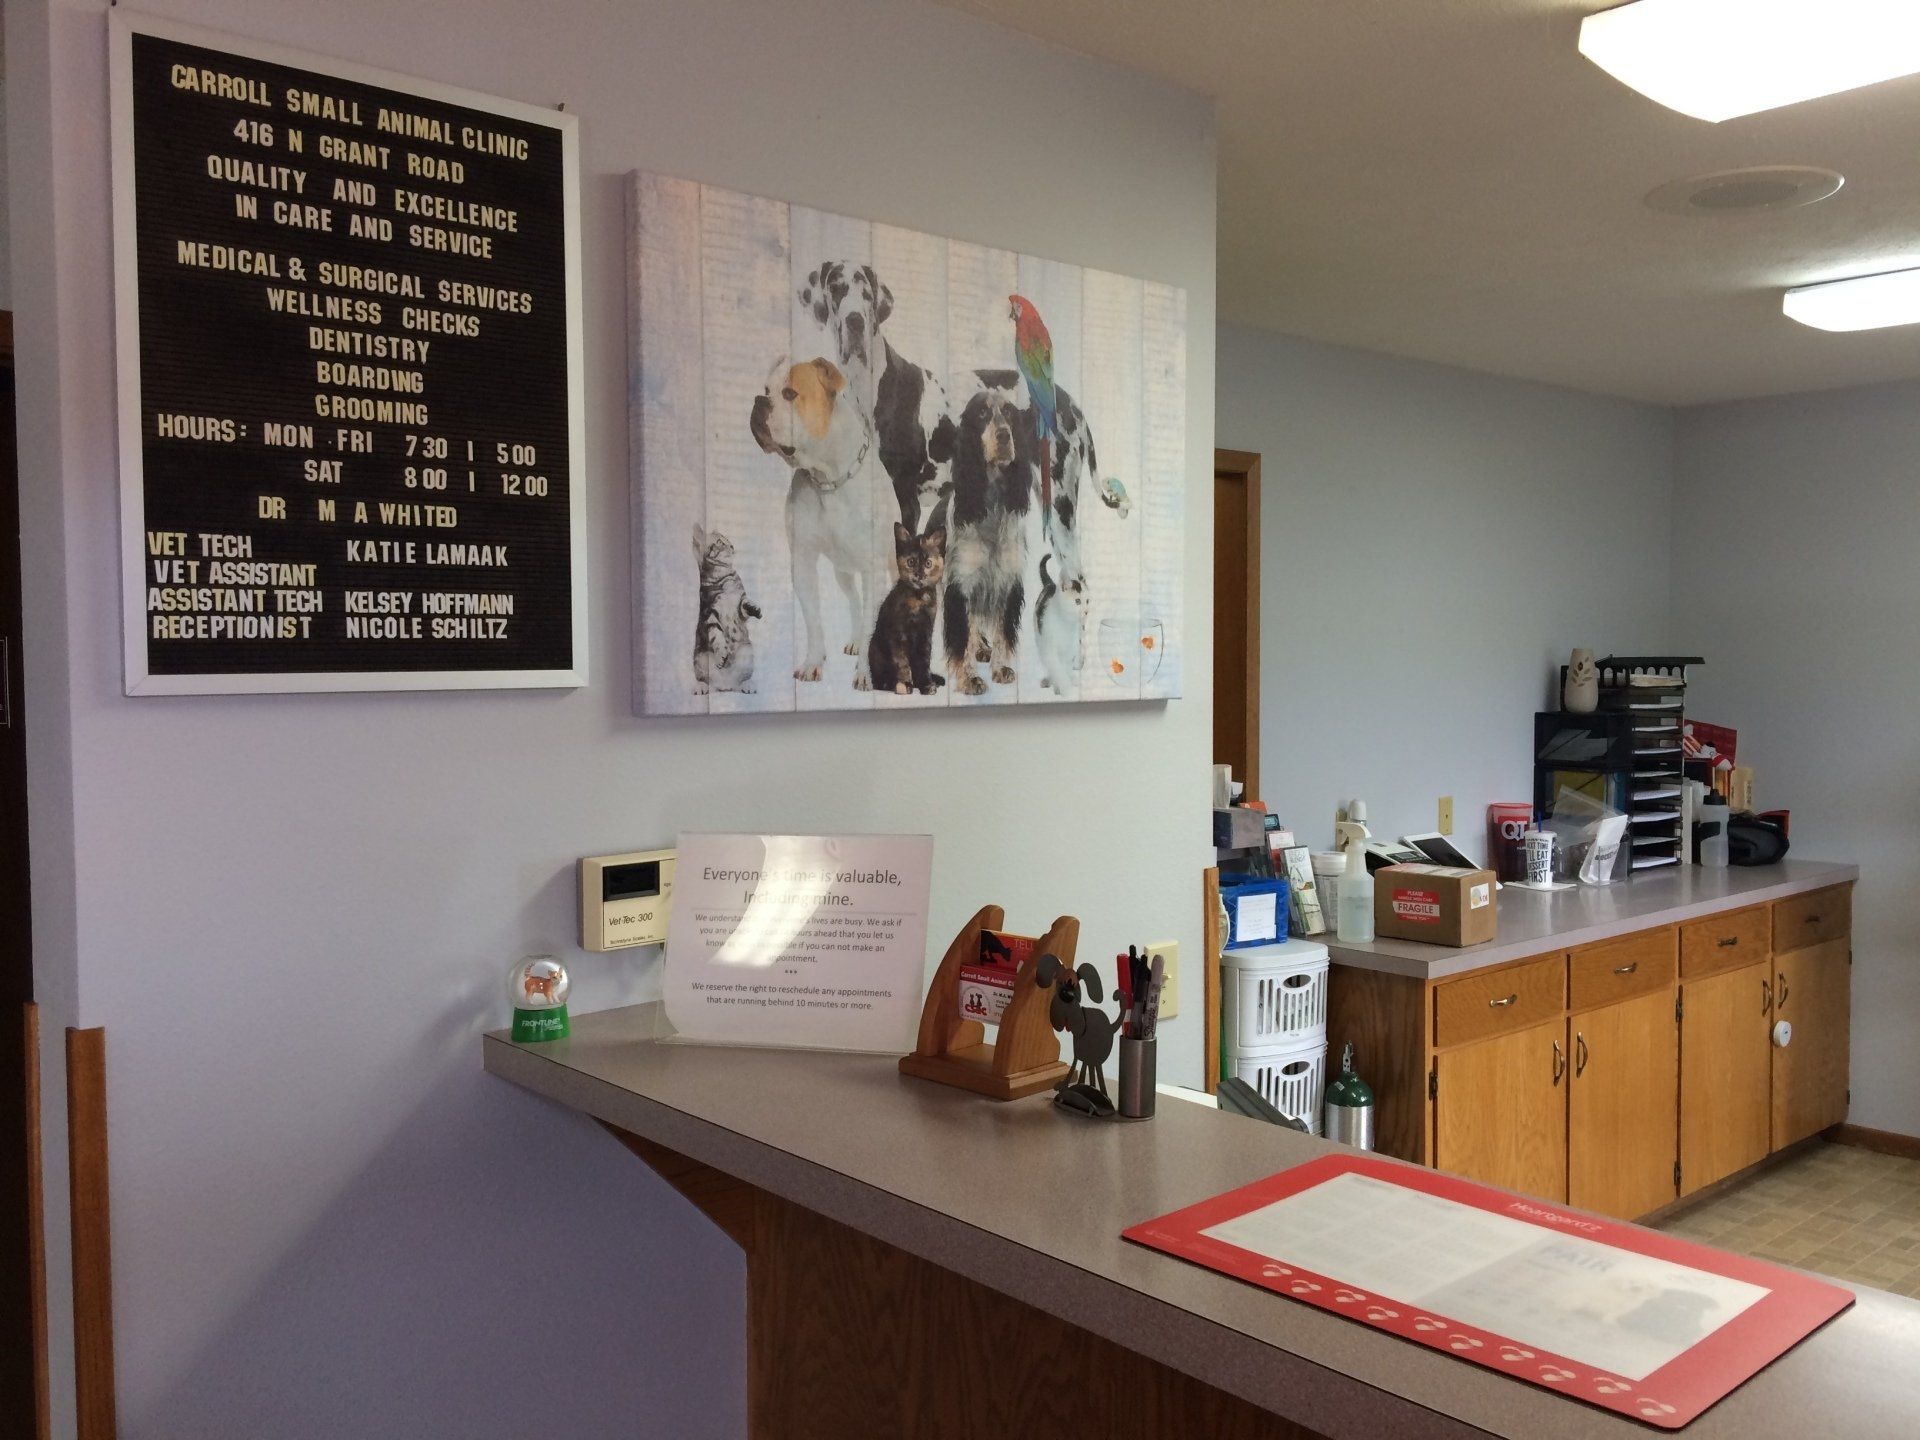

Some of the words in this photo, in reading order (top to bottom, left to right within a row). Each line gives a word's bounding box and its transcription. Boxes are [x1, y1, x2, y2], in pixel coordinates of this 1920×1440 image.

[172, 64, 271, 106] CARROLL
[287, 89, 362, 125] SMALL
[378, 109, 454, 144] ANIMAL
[462, 128, 528, 160] CLINIC
[234, 120, 273, 146] 416
[289, 129, 302, 152] N
[320, 136, 390, 169] GRANT
[408, 153, 463, 183] ROAD
[208, 155, 306, 193] QUALITY
[334, 179, 375, 206] AND
[396, 190, 517, 232] EXCELLENCE
[236, 194, 256, 219] IN
[274, 202, 332, 231] CARE
[350, 215, 392, 241] AND
[410, 225, 491, 258] SERVICE
[178, 241, 280, 277] MEDICAL
[289, 258, 306, 281] &
[319, 262, 424, 298] SURGICAL
[439, 280, 532, 313] SERVICES
[267, 288, 381, 324] WELLNESS
[403, 307, 480, 336] CHECKS
[310, 327, 429, 364] DENTISTRY
[317, 361, 423, 393] BOARDING
[316, 395, 427, 425] GROOMING
[159, 414, 246, 442] HOURS:
[265, 423, 313, 448] MON
[338, 429, 372, 452] FRI
[305, 460, 342, 483] SAT
[259, 496, 285, 519] DR
[319, 500, 335, 521] M
[355, 502, 368, 523] A
[379, 503, 456, 527] WHITED
[148, 532, 187, 555] VET
[199, 534, 252, 557] TECH
[347, 540, 416, 563] KATIE
[427, 544, 507, 566] LAMAAK
[154, 560, 199, 584] VET
[209, 562, 316, 586] ASSISTANT
[148, 588, 266, 612] ASSISTANT
[274, 590, 322, 612] TECH
[345, 591, 412, 613] KELSEY
[422, 593, 513, 615] HOFFMANN
[154, 615, 311, 638] RECEPTIONIST
[347, 617, 422, 638] NICOLE
[432, 618, 507, 638] SCHILTZ
[1501, 820, 1528, 841] QT
[1537, 850, 1548, 859] EAT
[820, 868, 832, 882] is
[836, 869, 902, 886] valuable,
[1528, 870, 1548, 883] FIRST
[813, 892, 853, 906] mine.
[1398, 903, 1434, 914] FRAGILE
[638, 912, 653, 922] 300
[695, 913, 708, 921] We
[709, 913, 752, 923] understa
[700, 928, 714, 936] you
[814, 930, 837, 938] ahead
[839, 930, 854, 938] that
[857, 932, 871, 940] you
[873, 931, 883, 939] let
[768, 954, 818, 964] ppointment.
[805, 943, 820, 951] you
[852, 944, 873, 952] make
[692, 982, 704, 990] We
[735, 984, 747, 992] the
[749, 984, 767, 994] right
[778, 985, 820, 995] reschedule
[821, 989, 836, 997] any
[838, 988, 892, 998] appointments
[991, 977, 1007, 985] Animal
[707, 996, 722, 1004] that
[738, 997, 766, 1006] running
[768, 998, 794, 1006] behind
[807, 1000, 838, 1009] minutes
